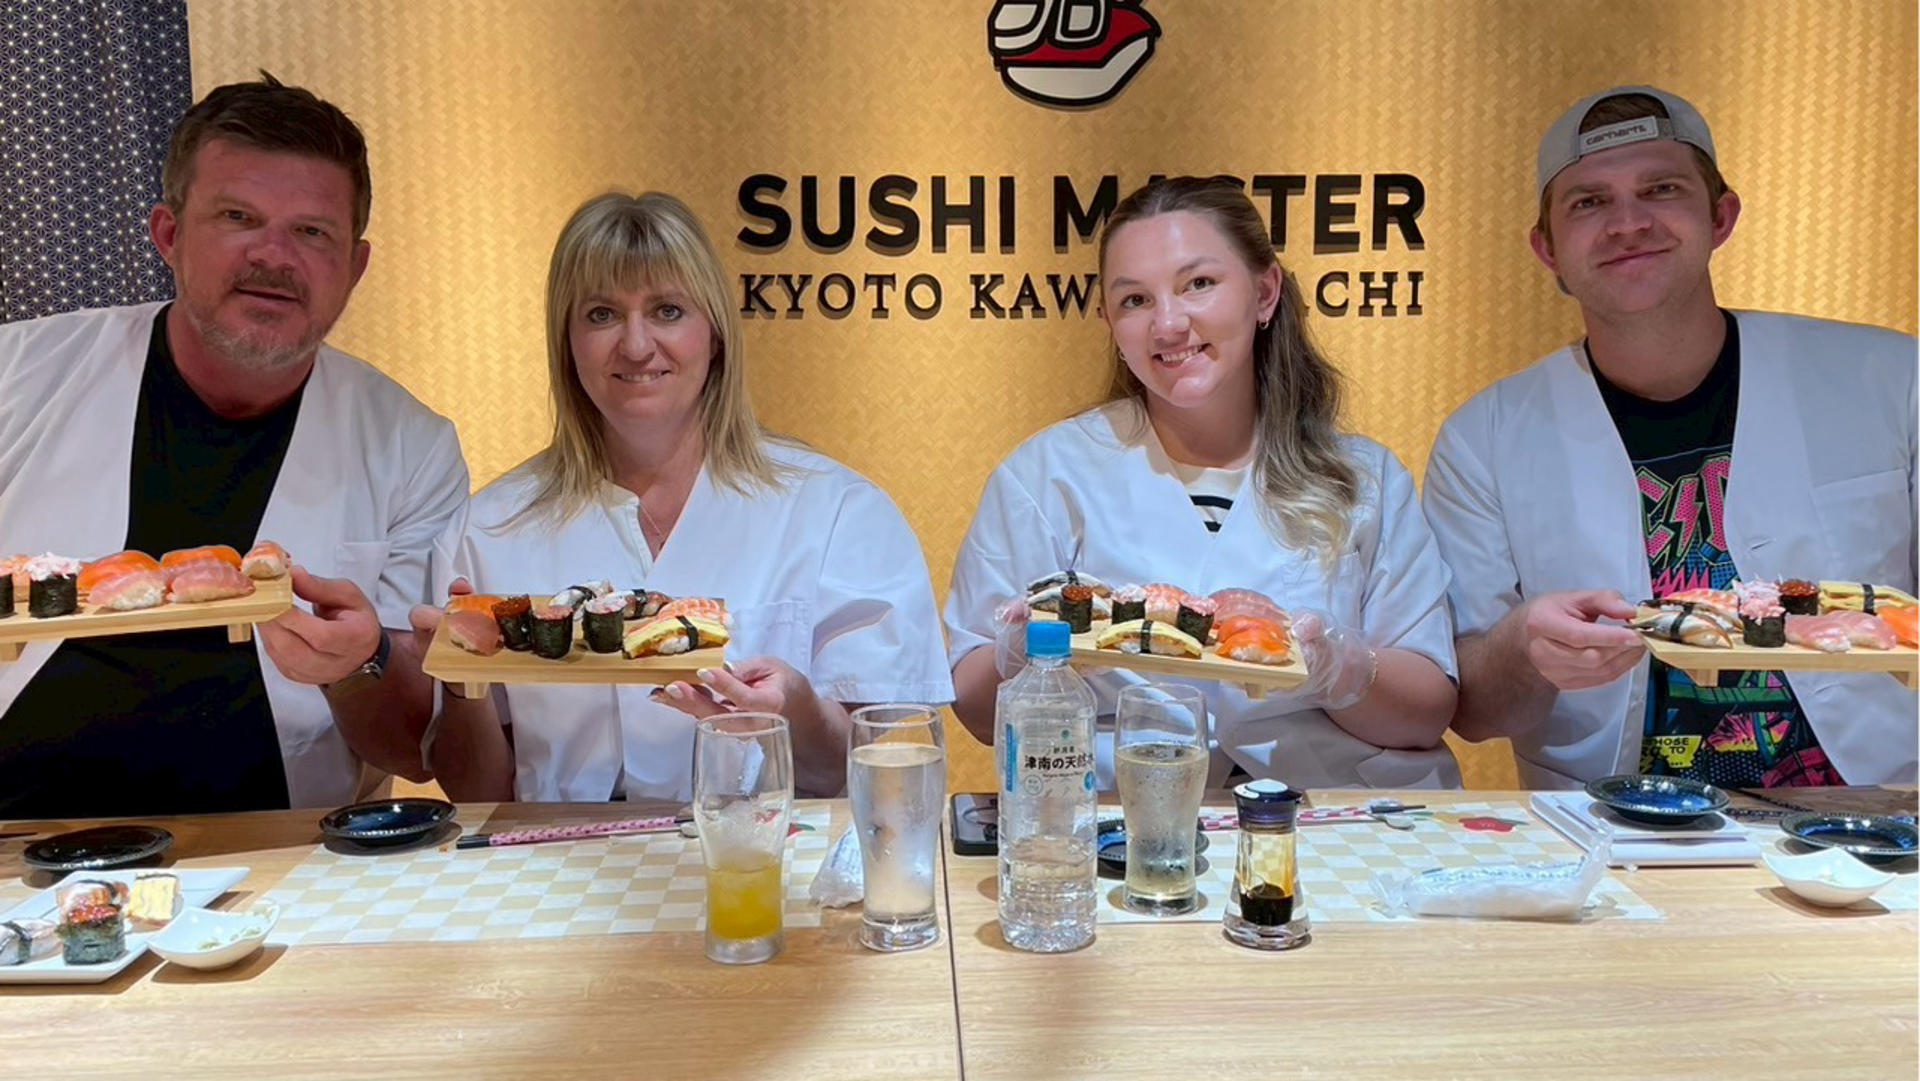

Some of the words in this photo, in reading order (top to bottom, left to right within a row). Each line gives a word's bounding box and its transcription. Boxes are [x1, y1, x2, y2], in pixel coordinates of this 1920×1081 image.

[737, 174, 1016, 251] SUSHI
[1053, 174, 1425, 251] MTER
[740, 273, 942, 317] KYOTO
